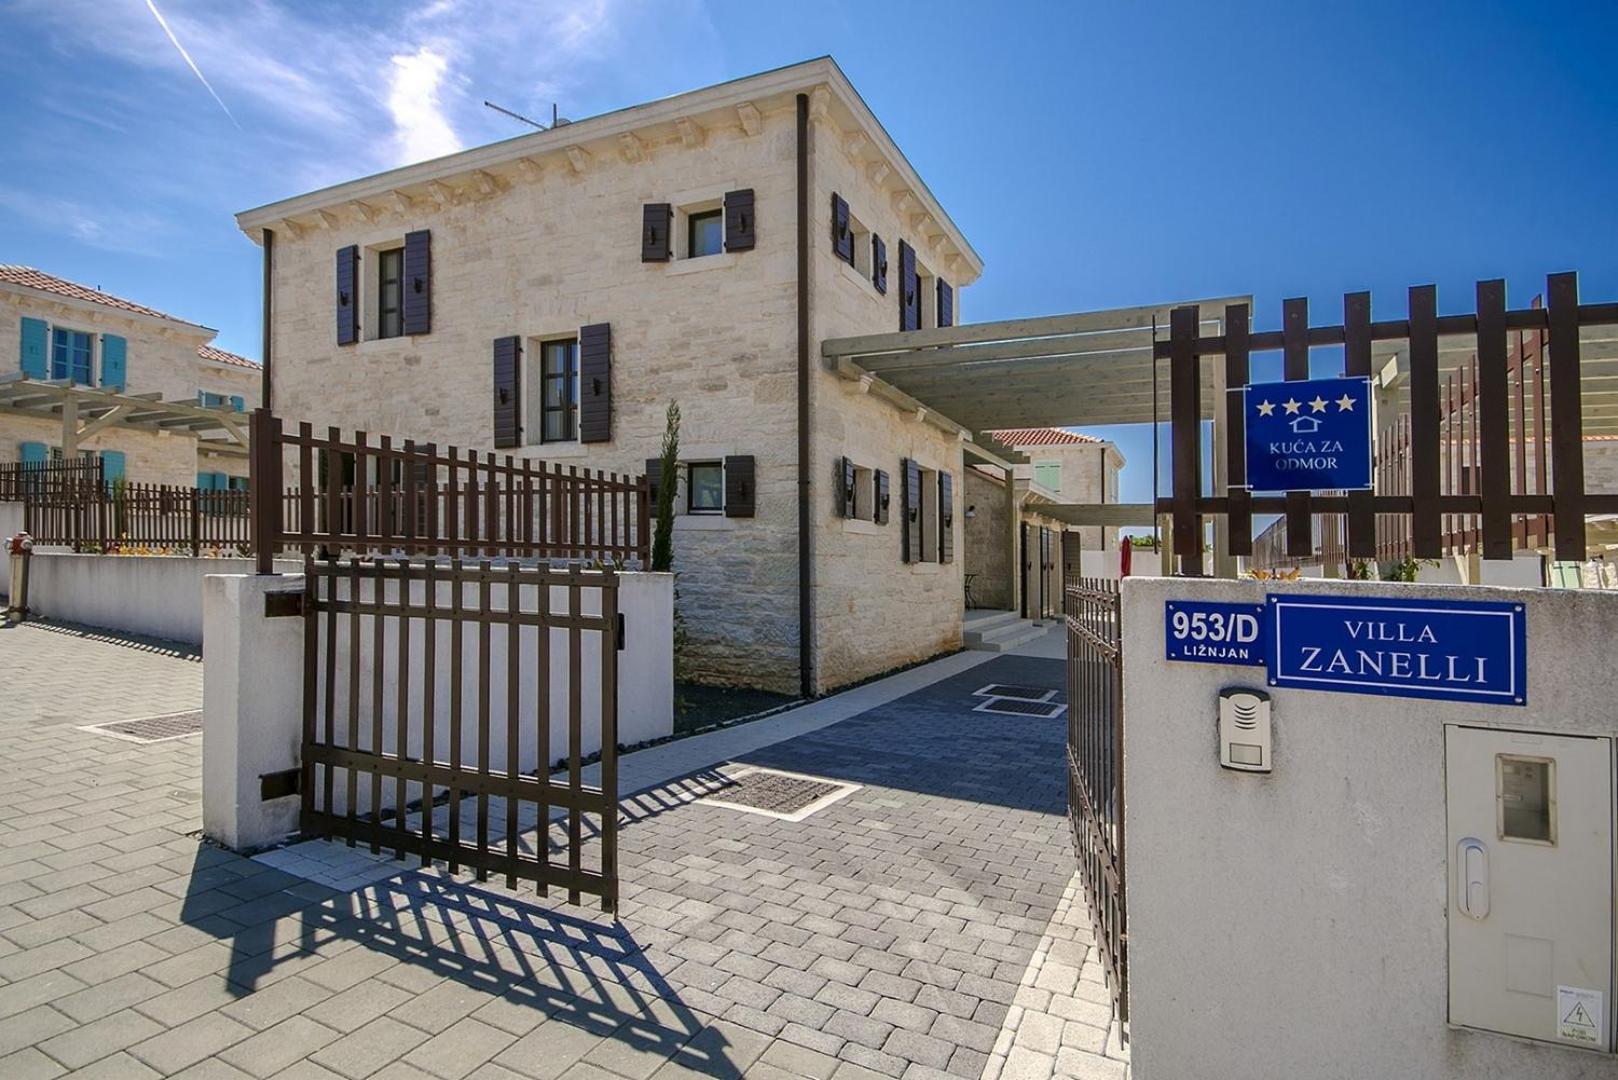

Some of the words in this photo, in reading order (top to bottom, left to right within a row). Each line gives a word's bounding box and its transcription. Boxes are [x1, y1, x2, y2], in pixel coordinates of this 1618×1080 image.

[1270, 438, 1316, 454] KUĆA
[1320, 440, 1344, 453] ZA
[1275, 456, 1338, 471] ODMOR
[1172, 611, 1259, 643] 953/D
[1344, 620, 1439, 643] VILLA
[1184, 644, 1249, 659] LIŽNJAN
[1300, 646, 1488, 683] ZANELLI
